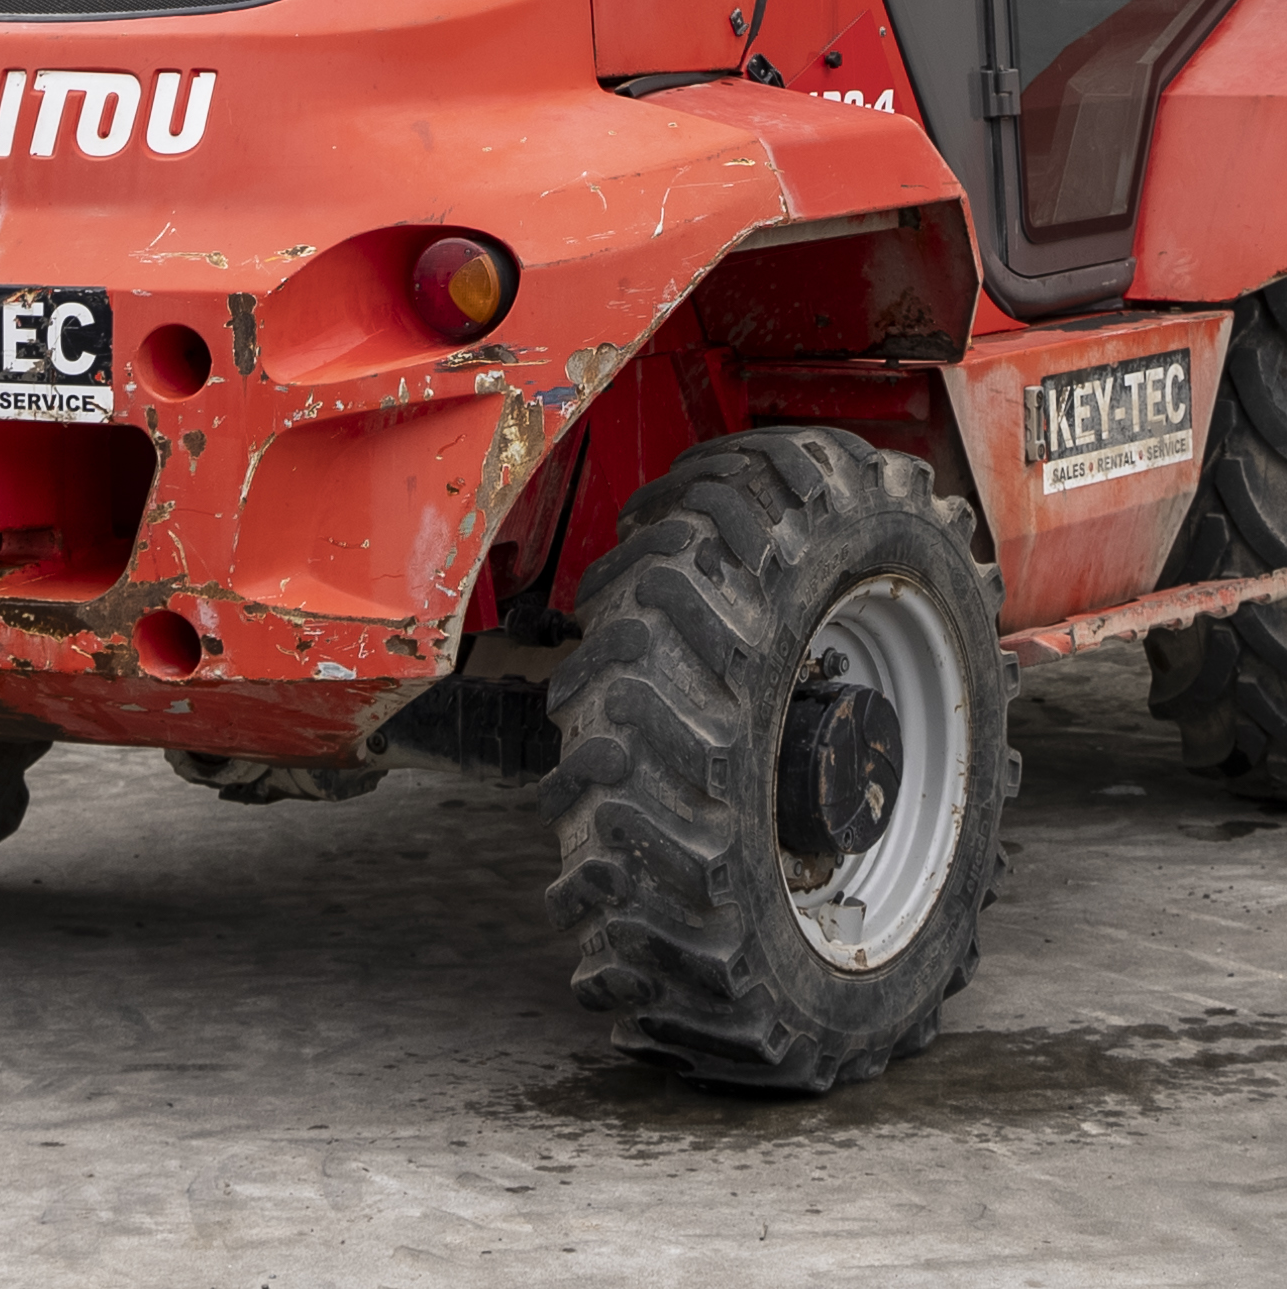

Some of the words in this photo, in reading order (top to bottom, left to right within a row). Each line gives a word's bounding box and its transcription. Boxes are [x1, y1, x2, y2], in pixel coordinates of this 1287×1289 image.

[1048, 362, 1187, 452] KEY-TEC
[1052, 461, 1086, 484] SALES
[1096, 450, 1137, 473] RENTAL
[1146, 437, 1187, 462] SERVICE
